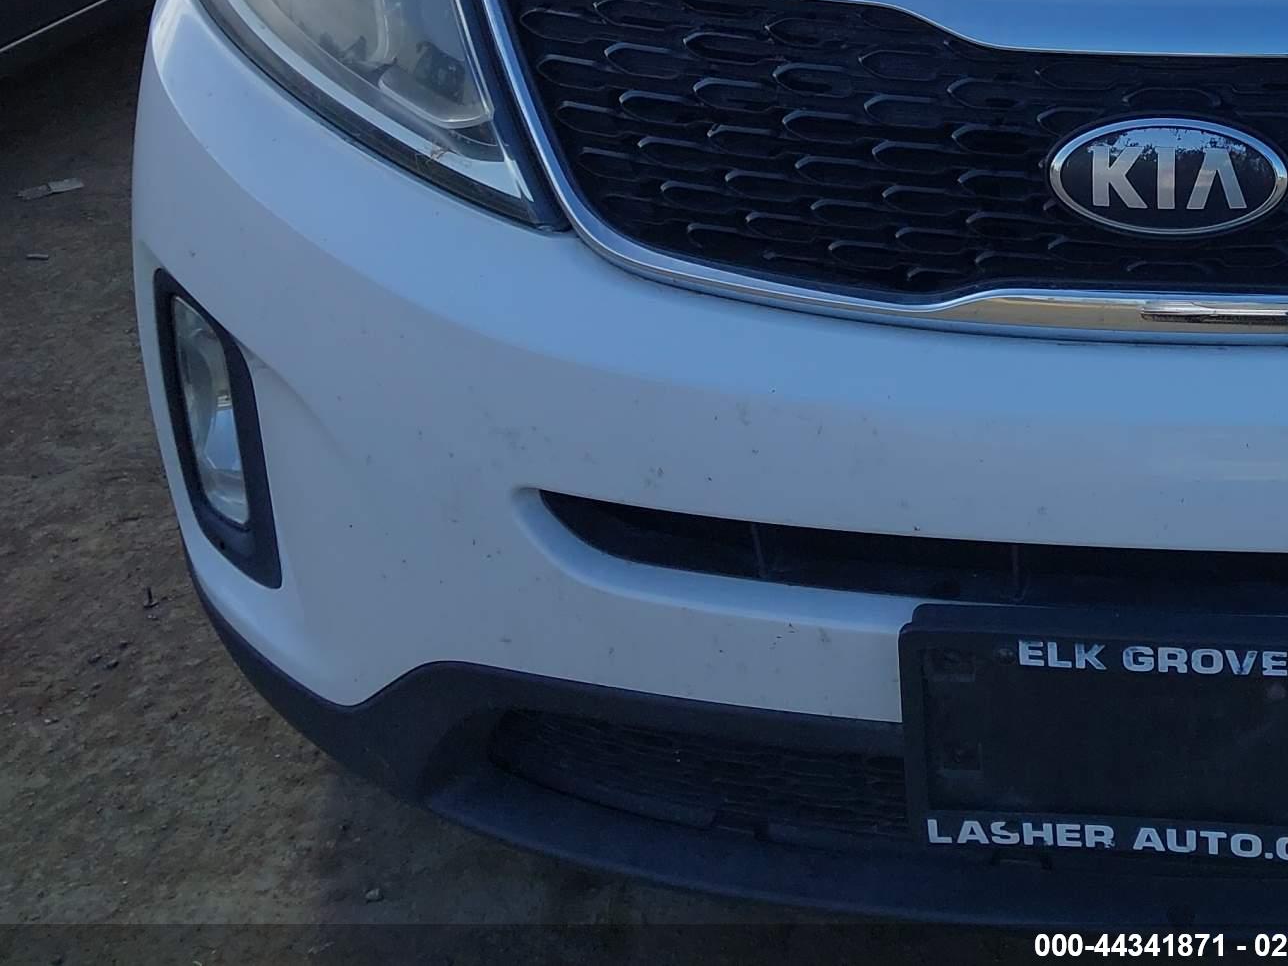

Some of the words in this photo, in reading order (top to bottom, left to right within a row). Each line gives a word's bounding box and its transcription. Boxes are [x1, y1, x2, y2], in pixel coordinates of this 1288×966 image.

[1089, 145, 1248, 210] KIA
[1018, 641, 1107, 670] ELK
[1122, 646, 1288, 676] GROVE
[927, 819, 1114, 848] LASHER
